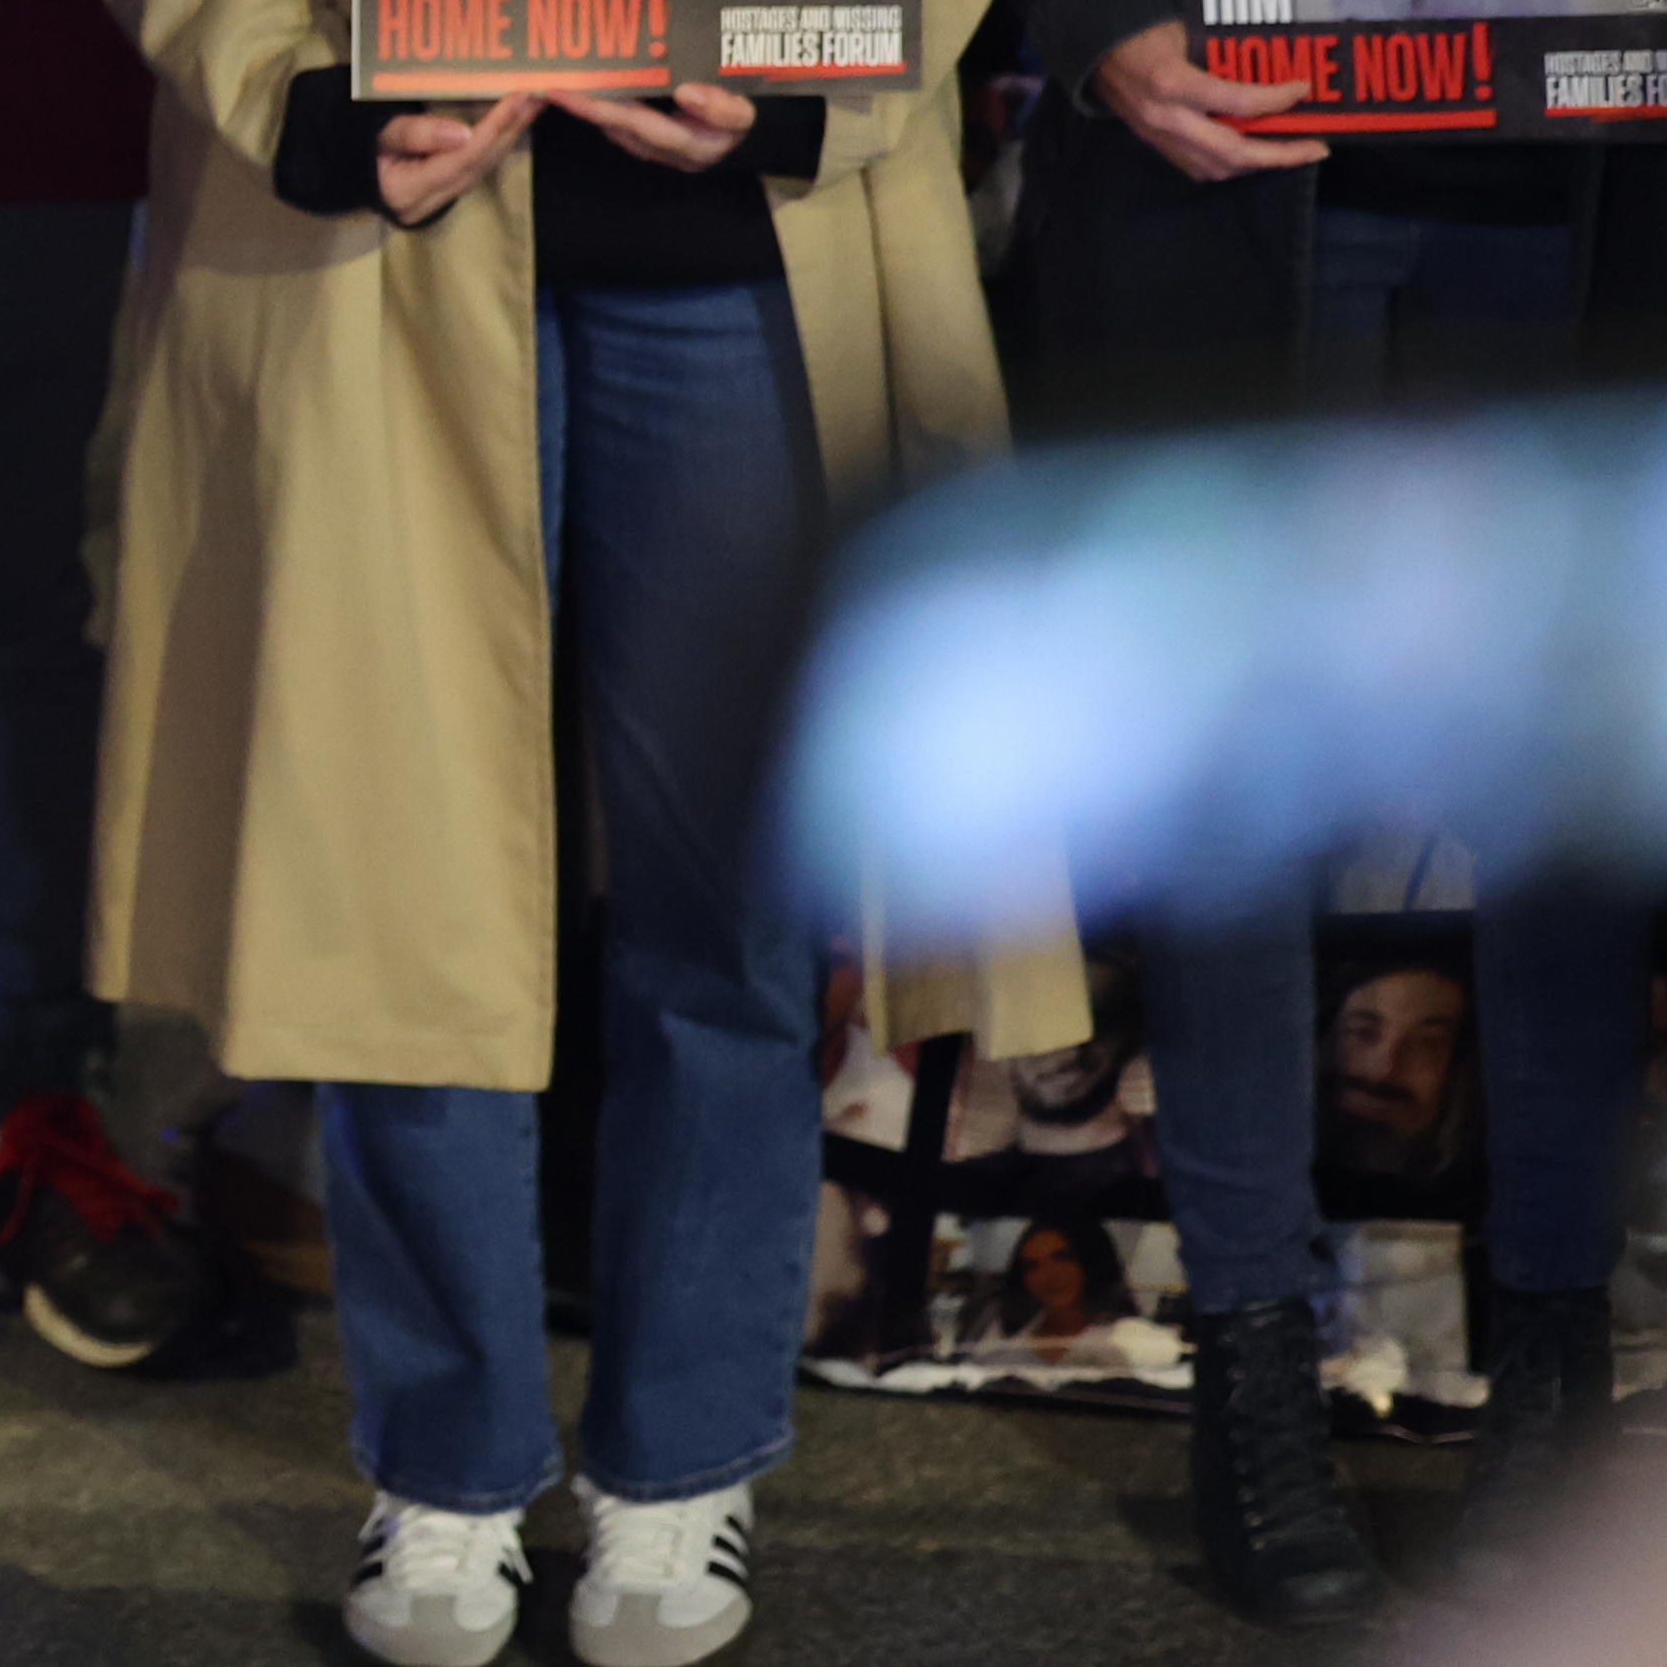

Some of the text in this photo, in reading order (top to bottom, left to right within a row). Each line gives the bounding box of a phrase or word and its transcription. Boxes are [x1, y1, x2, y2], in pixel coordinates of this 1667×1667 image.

[833, 5, 903, 31] MISSING
[720, 31, 903, 67] FAMILIES FORUM
[1205, 22, 1493, 103] HOME NOW!
